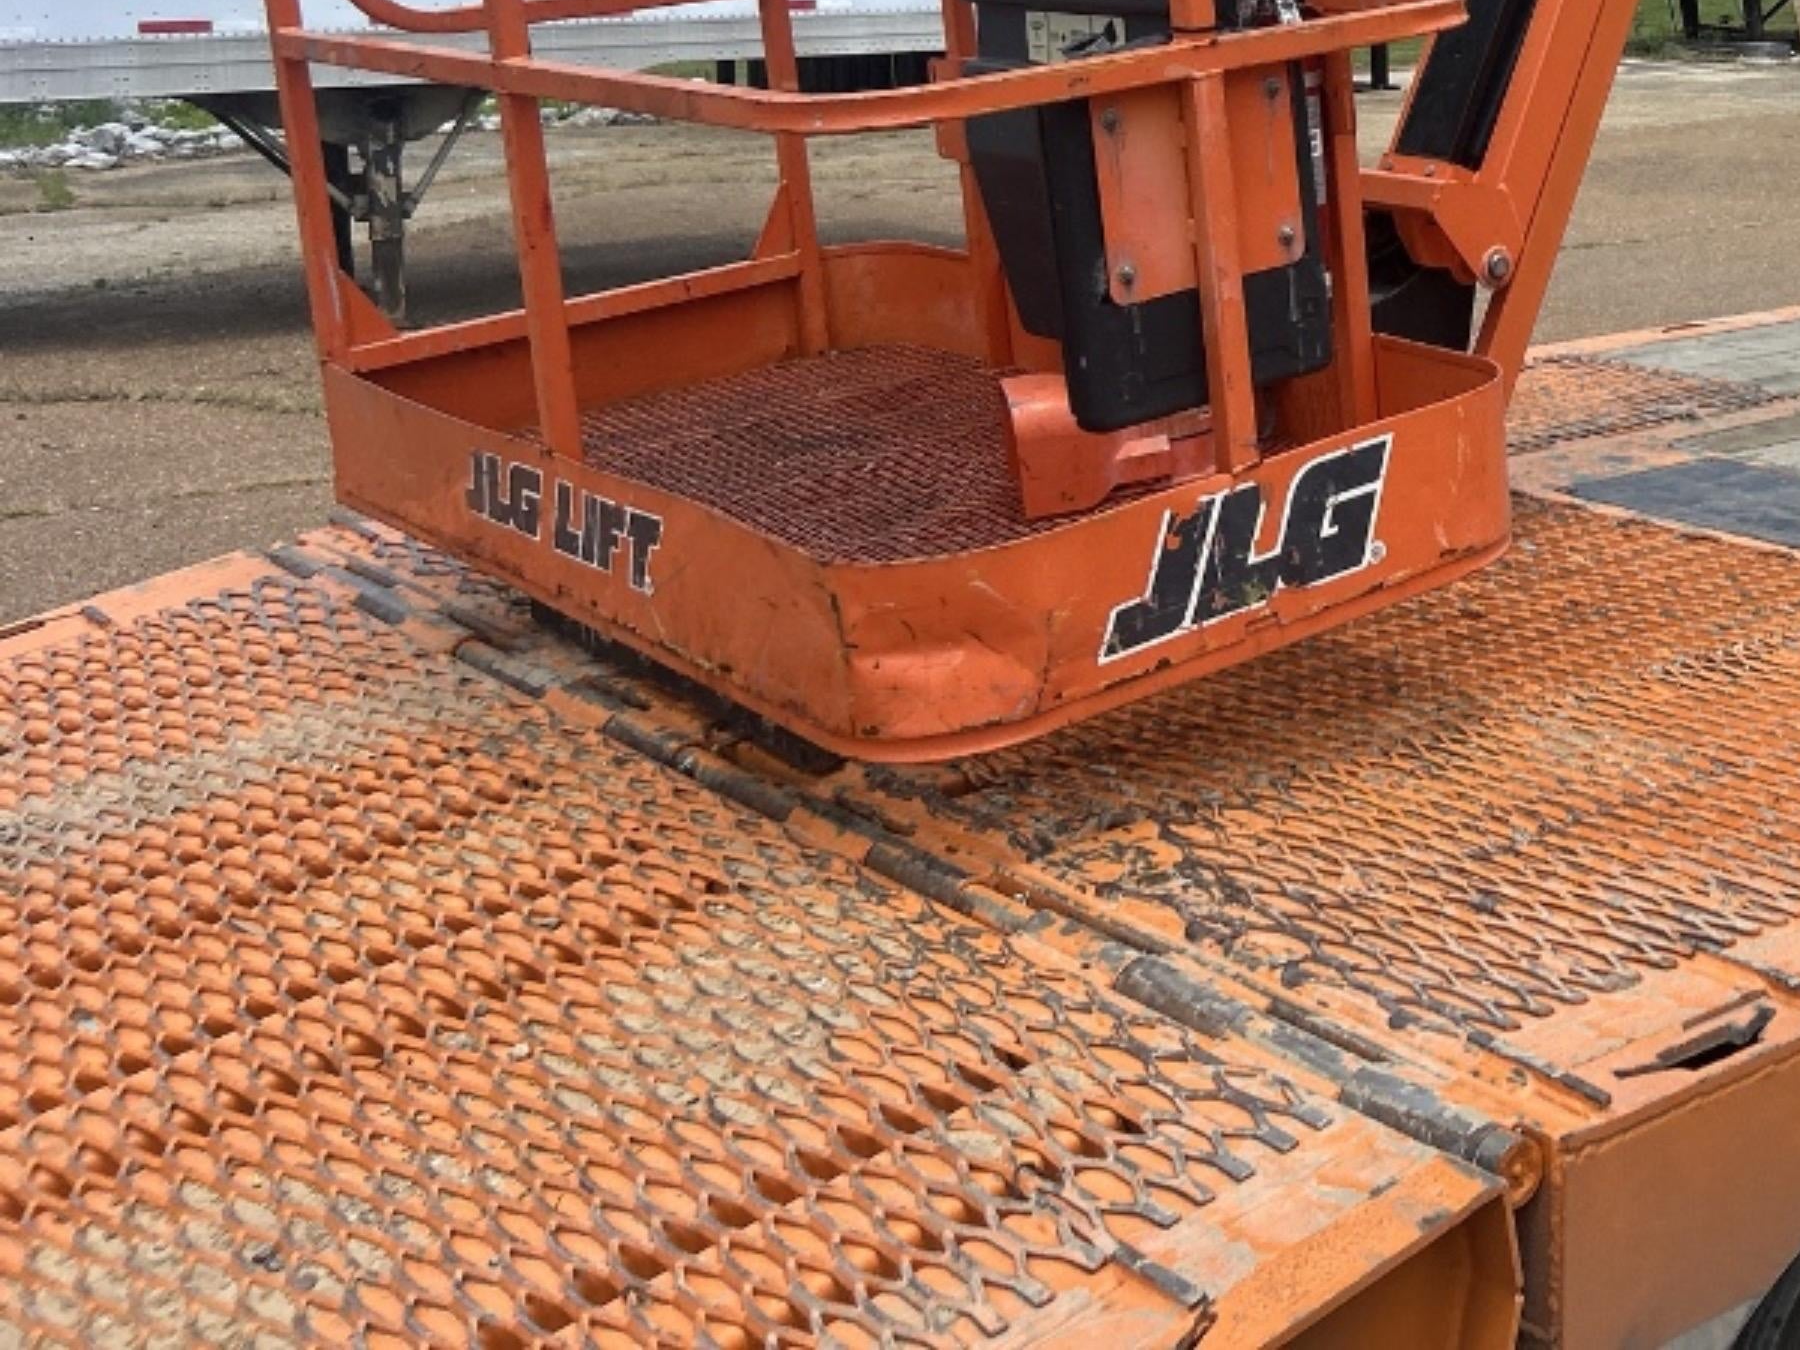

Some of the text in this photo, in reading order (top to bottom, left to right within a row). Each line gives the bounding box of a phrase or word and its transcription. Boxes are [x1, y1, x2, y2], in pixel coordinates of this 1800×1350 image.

[465, 452, 664, 594] JLG LIFT
[1097, 432, 1394, 666] JLG
